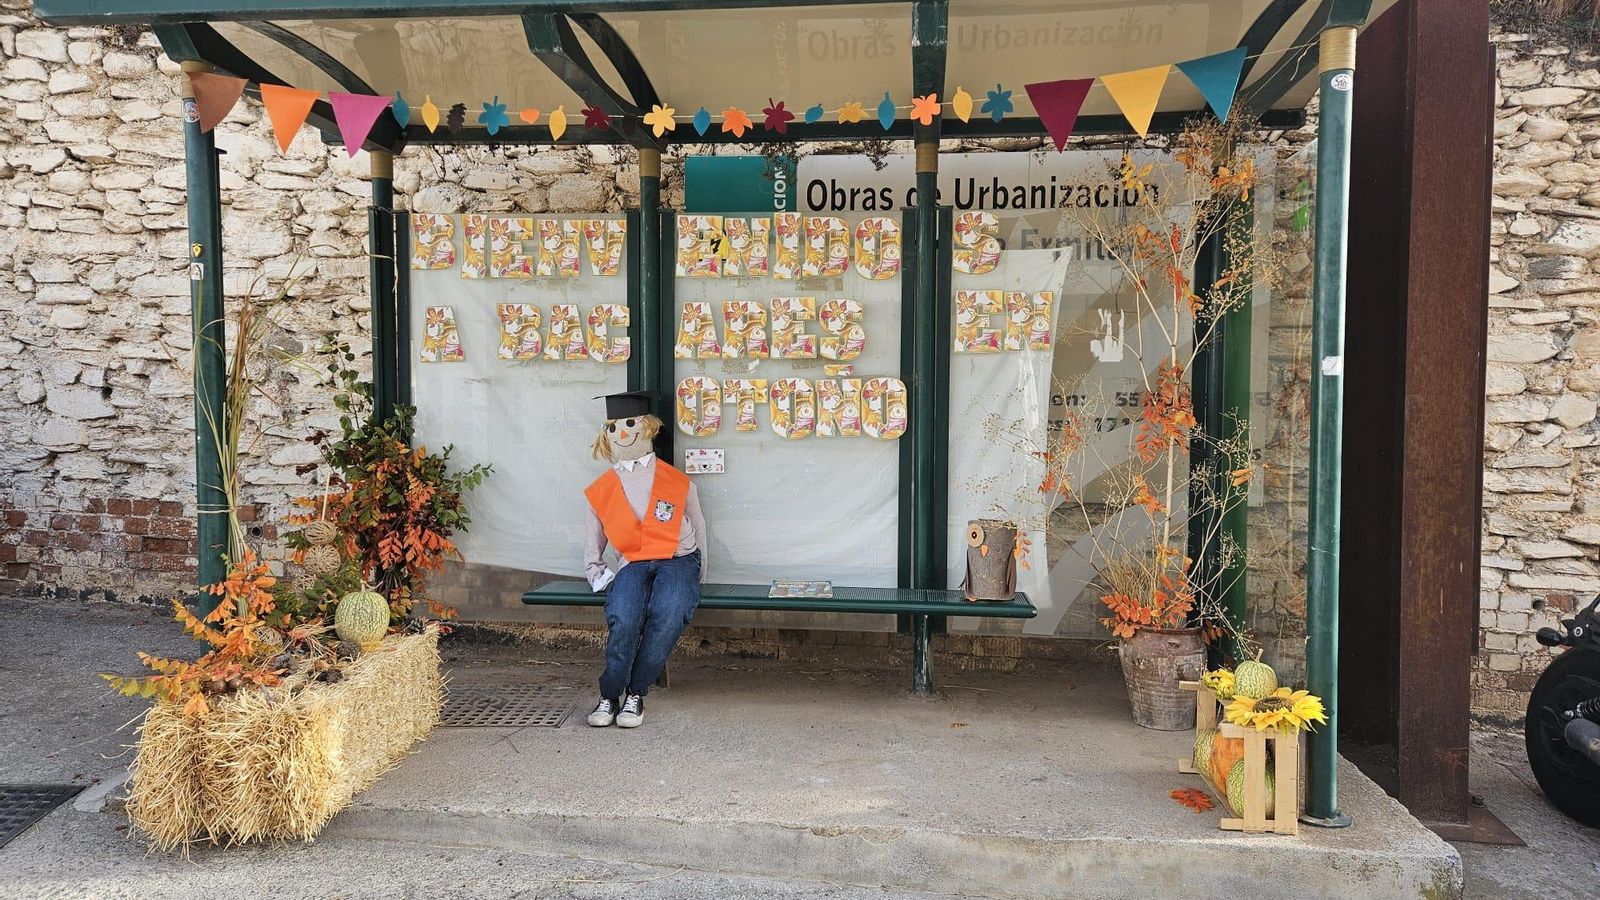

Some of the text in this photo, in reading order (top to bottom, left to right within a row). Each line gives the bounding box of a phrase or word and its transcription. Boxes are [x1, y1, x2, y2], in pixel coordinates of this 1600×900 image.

[806, 179, 893, 211] Obras
[420, 306, 464, 362] A
[954, 290, 1053, 352] EN
